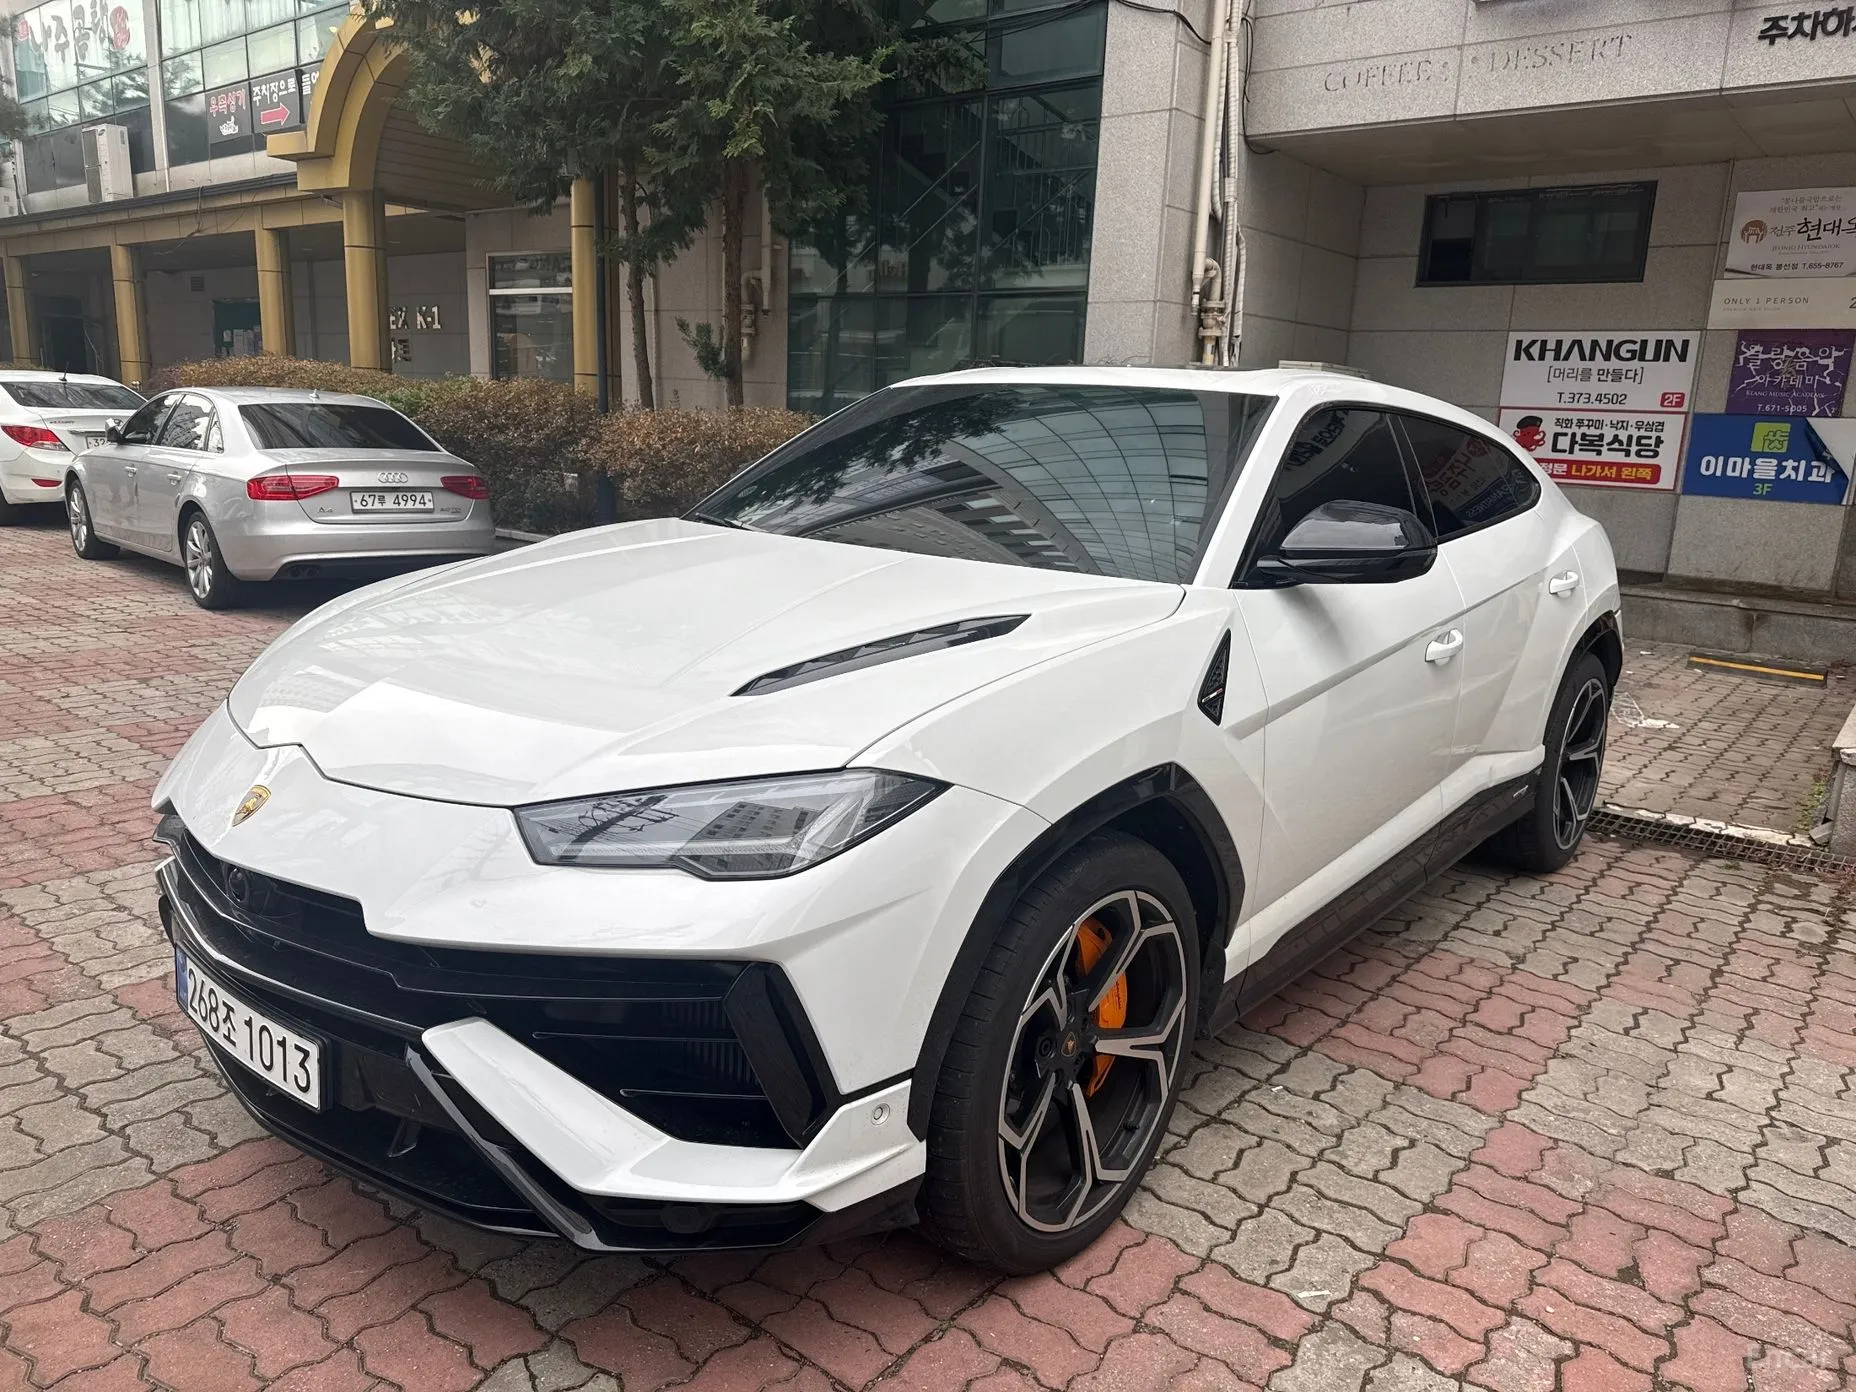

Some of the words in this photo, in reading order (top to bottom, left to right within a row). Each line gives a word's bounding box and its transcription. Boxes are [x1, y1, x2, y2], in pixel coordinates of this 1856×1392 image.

[1758, 6, 1856, 45] 주차하
[1324, 58, 1432, 93] COFFEE
[1489, 34, 1634, 73] DESSERT
[252, 77, 296, 107] 주차장으로
[1802, 261, 1844, 270] T.655-8767
[1723, 296, 1751, 305] ONLY
[1765, 296, 1810, 304] PERSON
[1513, 338, 1691, 363] KHANGUN
[1547, 366, 1593, 385] [머리를
[1596, 366, 1645, 385] 만들다]
[1757, 374, 1819, 389] 아카데미
[1557, 392, 1628, 406] T.373.4502
[1662, 394, 1684, 407] 2F
[1757, 404, 1808, 413] T.671-5005
[1554, 417, 1574, 430] 직화
[1550, 432, 1665, 459] 다복식당
[1571, 464, 1617, 479] 나가서
[1621, 466, 1653, 480] 왼쪽
[1699, 454, 1837, 484] 이마을치과
[1752, 483, 1772, 496] 3F
[360, 493, 386, 508] 67루
[393, 493, 427, 508] 4994
[187, 966, 238, 1048] 268조
[243, 1014, 312, 1094] 1013
